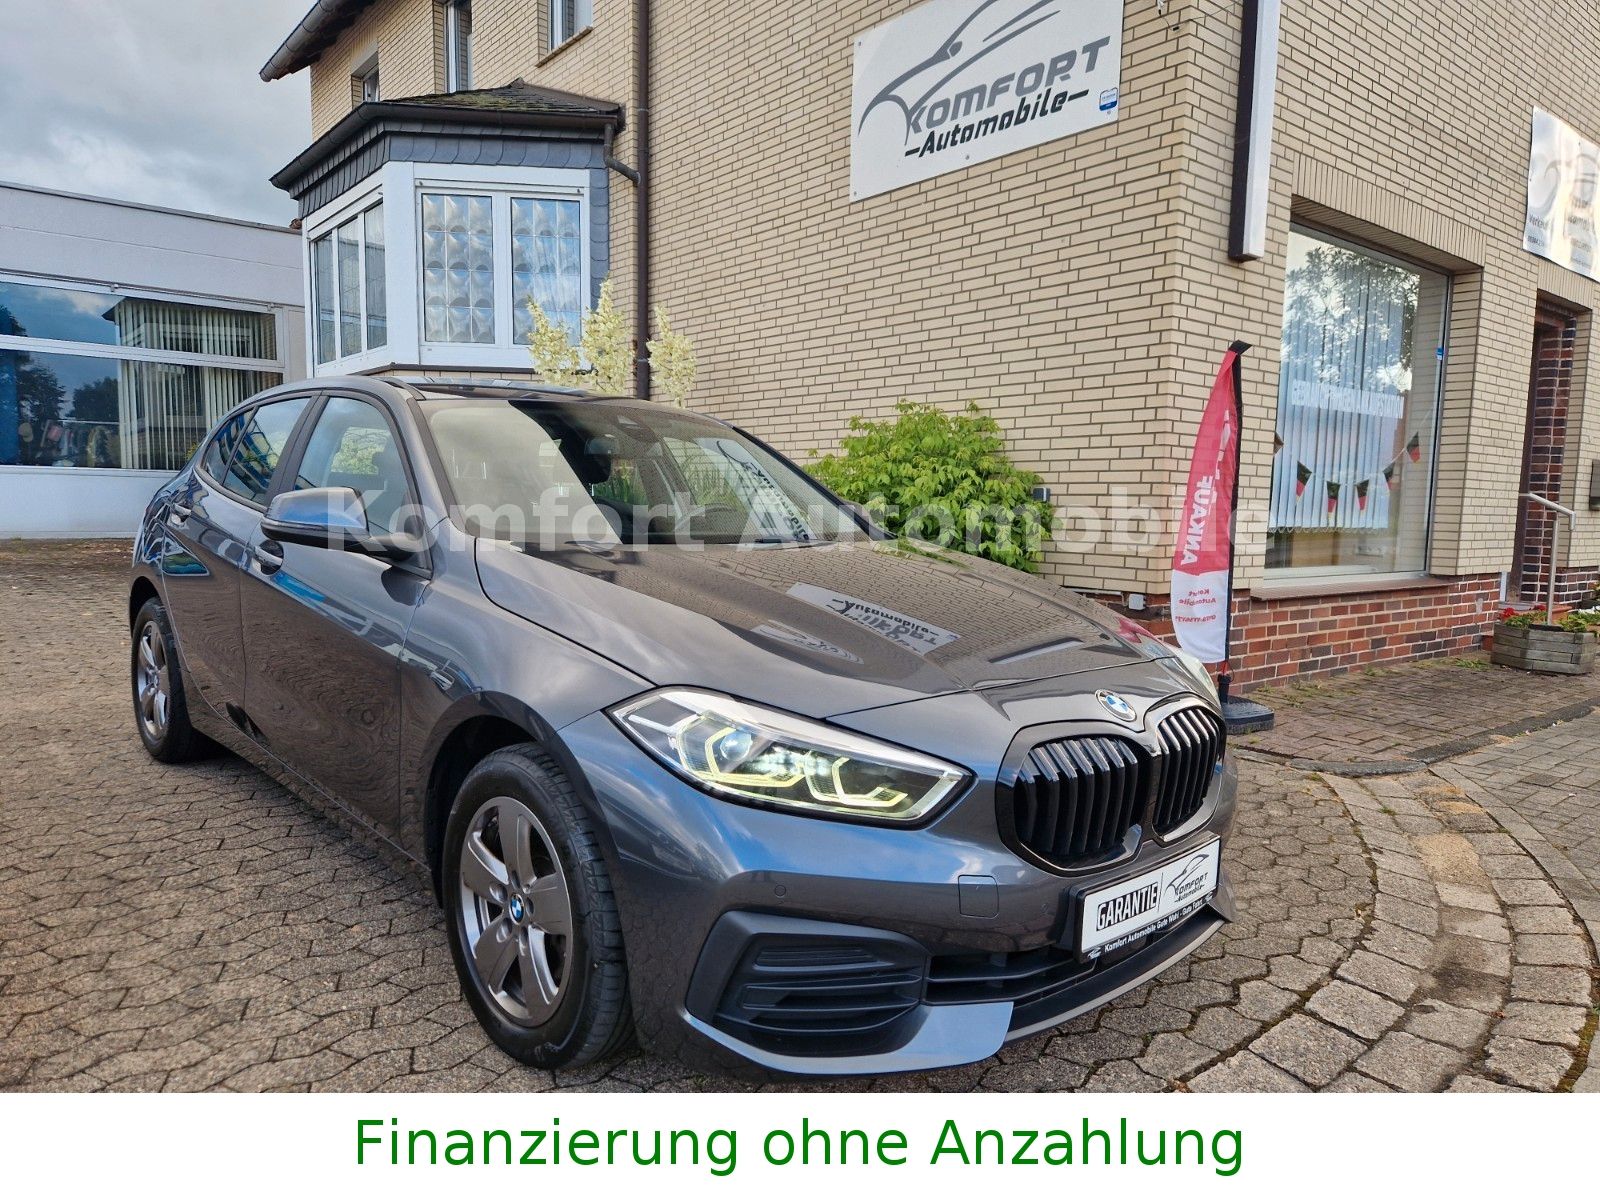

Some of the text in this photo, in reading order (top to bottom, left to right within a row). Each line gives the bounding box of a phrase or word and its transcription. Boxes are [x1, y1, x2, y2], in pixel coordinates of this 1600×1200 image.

[909, 36, 1111, 135] KOMFORT
[1096, 882, 1159, 931] GARANTIE
[1104, 937, 1128, 953] Komfort
[1127, 923, 1157, 943] Automobile
